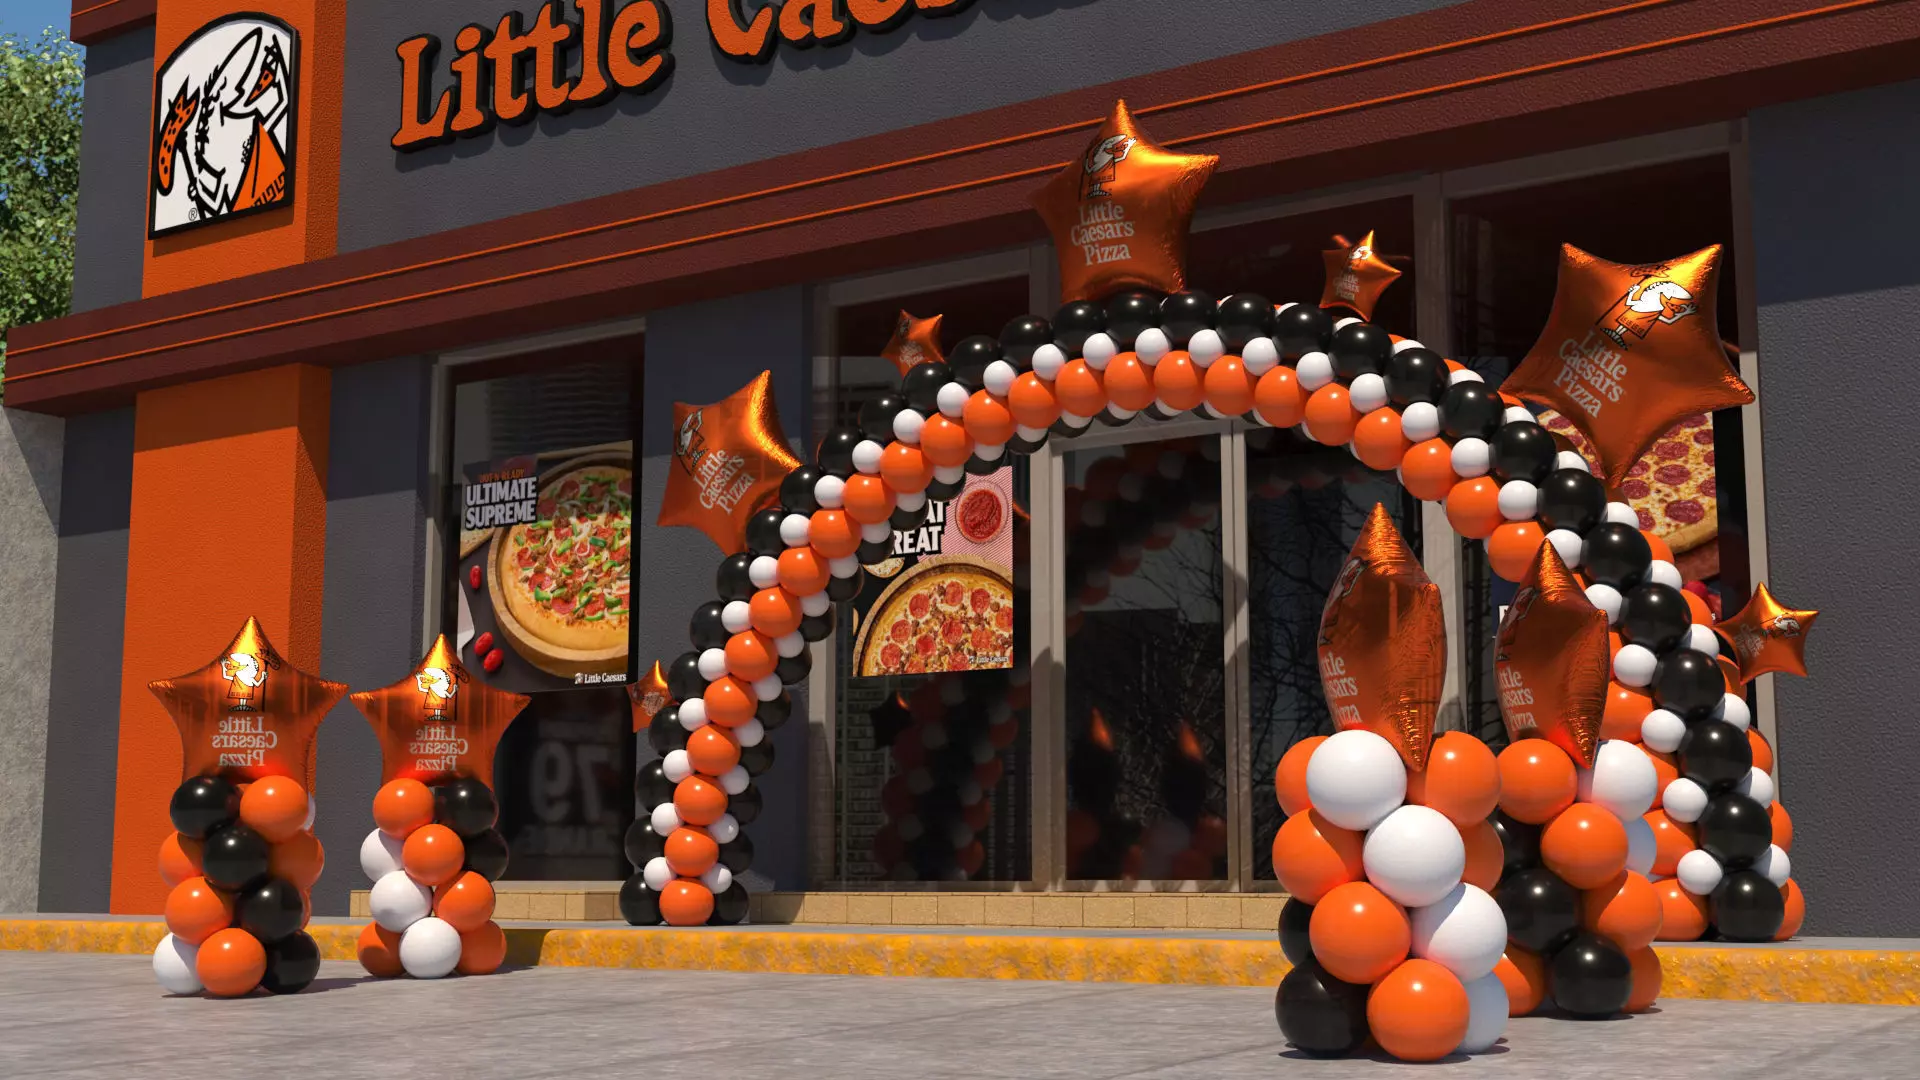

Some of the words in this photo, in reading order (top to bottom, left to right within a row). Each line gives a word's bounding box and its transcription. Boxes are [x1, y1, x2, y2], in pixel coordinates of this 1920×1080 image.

[391, 0, 665, 148] Little
[1079, 200, 1124, 227] Little
[1071, 221, 1135, 246] Caesars
[1082, 243, 1132, 267] Pizza
[1579, 329, 1628, 380] Little
[1559, 338, 1625, 402] Caesars
[1553, 365, 1602, 418] Pizza
[693, 449, 729, 491] Little
[699, 455, 745, 510] Caesars
[466, 476, 537, 506] ULTIMATE
[717, 473, 756, 515] Pizza
[465, 499, 537, 529] SUPREME
[926, 499, 944, 524] AT
[891, 525, 942, 555] REAT
[584, 673, 602, 684] Little
[602, 672, 627, 683] Caesars
